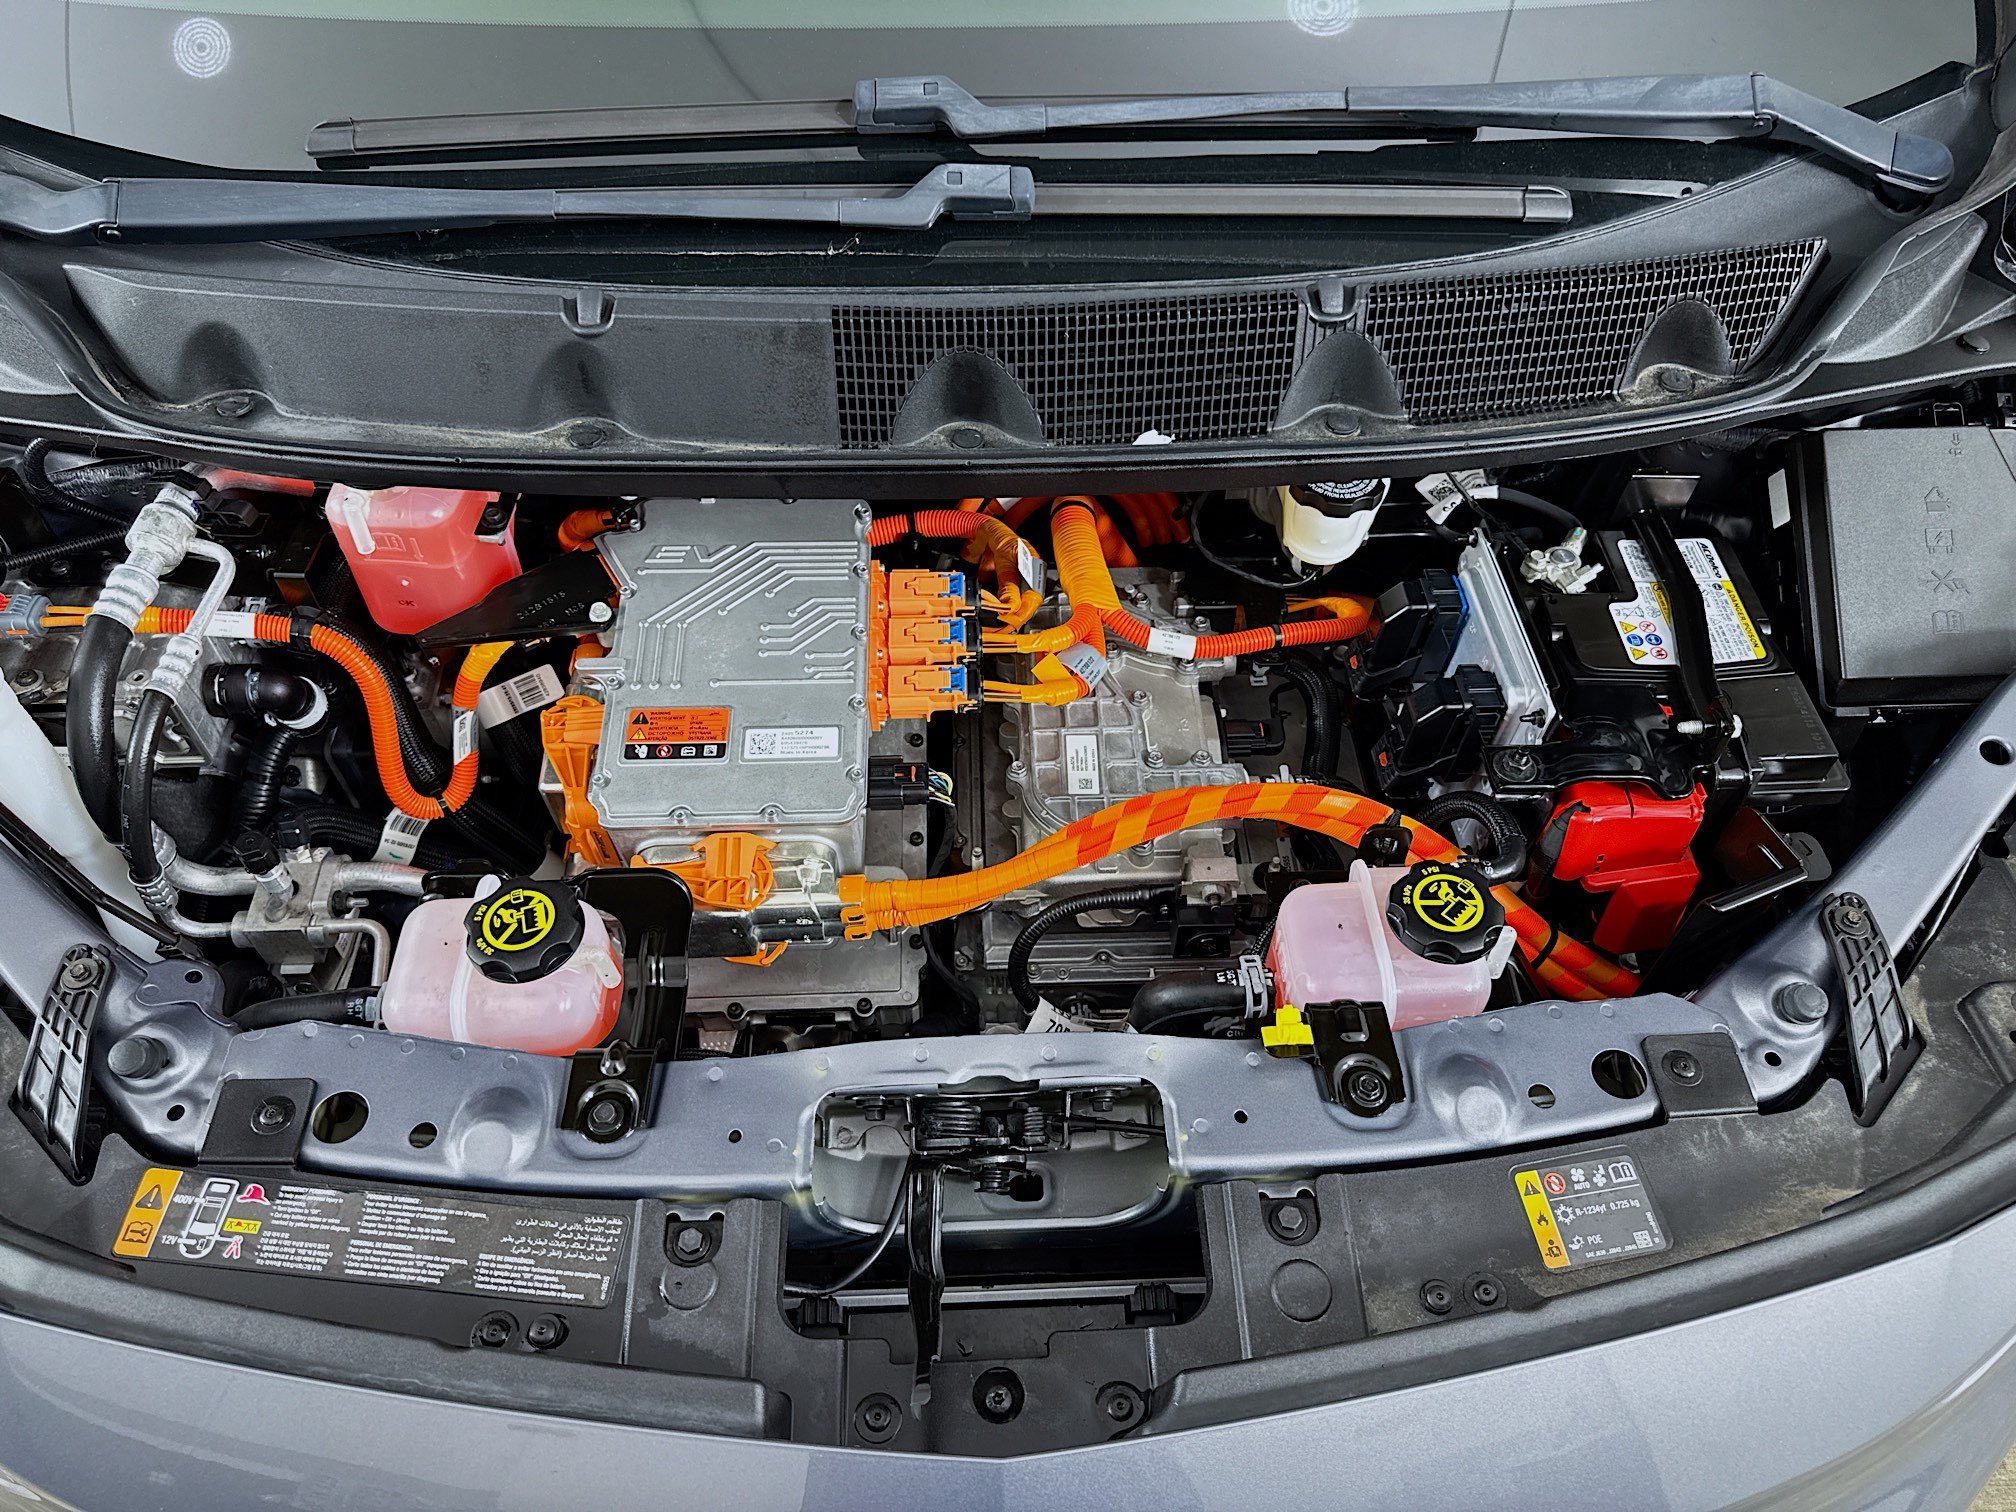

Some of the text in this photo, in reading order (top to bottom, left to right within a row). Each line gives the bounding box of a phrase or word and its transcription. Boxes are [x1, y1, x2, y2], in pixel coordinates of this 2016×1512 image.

[1324, 490, 1340, 498] FROM
[645, 545, 736, 562] EV
[1574, 1182, 1590, 1190] AUTO
[173, 1194, 194, 1205] 400V
[1630, 1199, 1641, 1209] kg
[162, 1235, 177, 1245] 12V
[1587, 1234, 1603, 1245] POE
